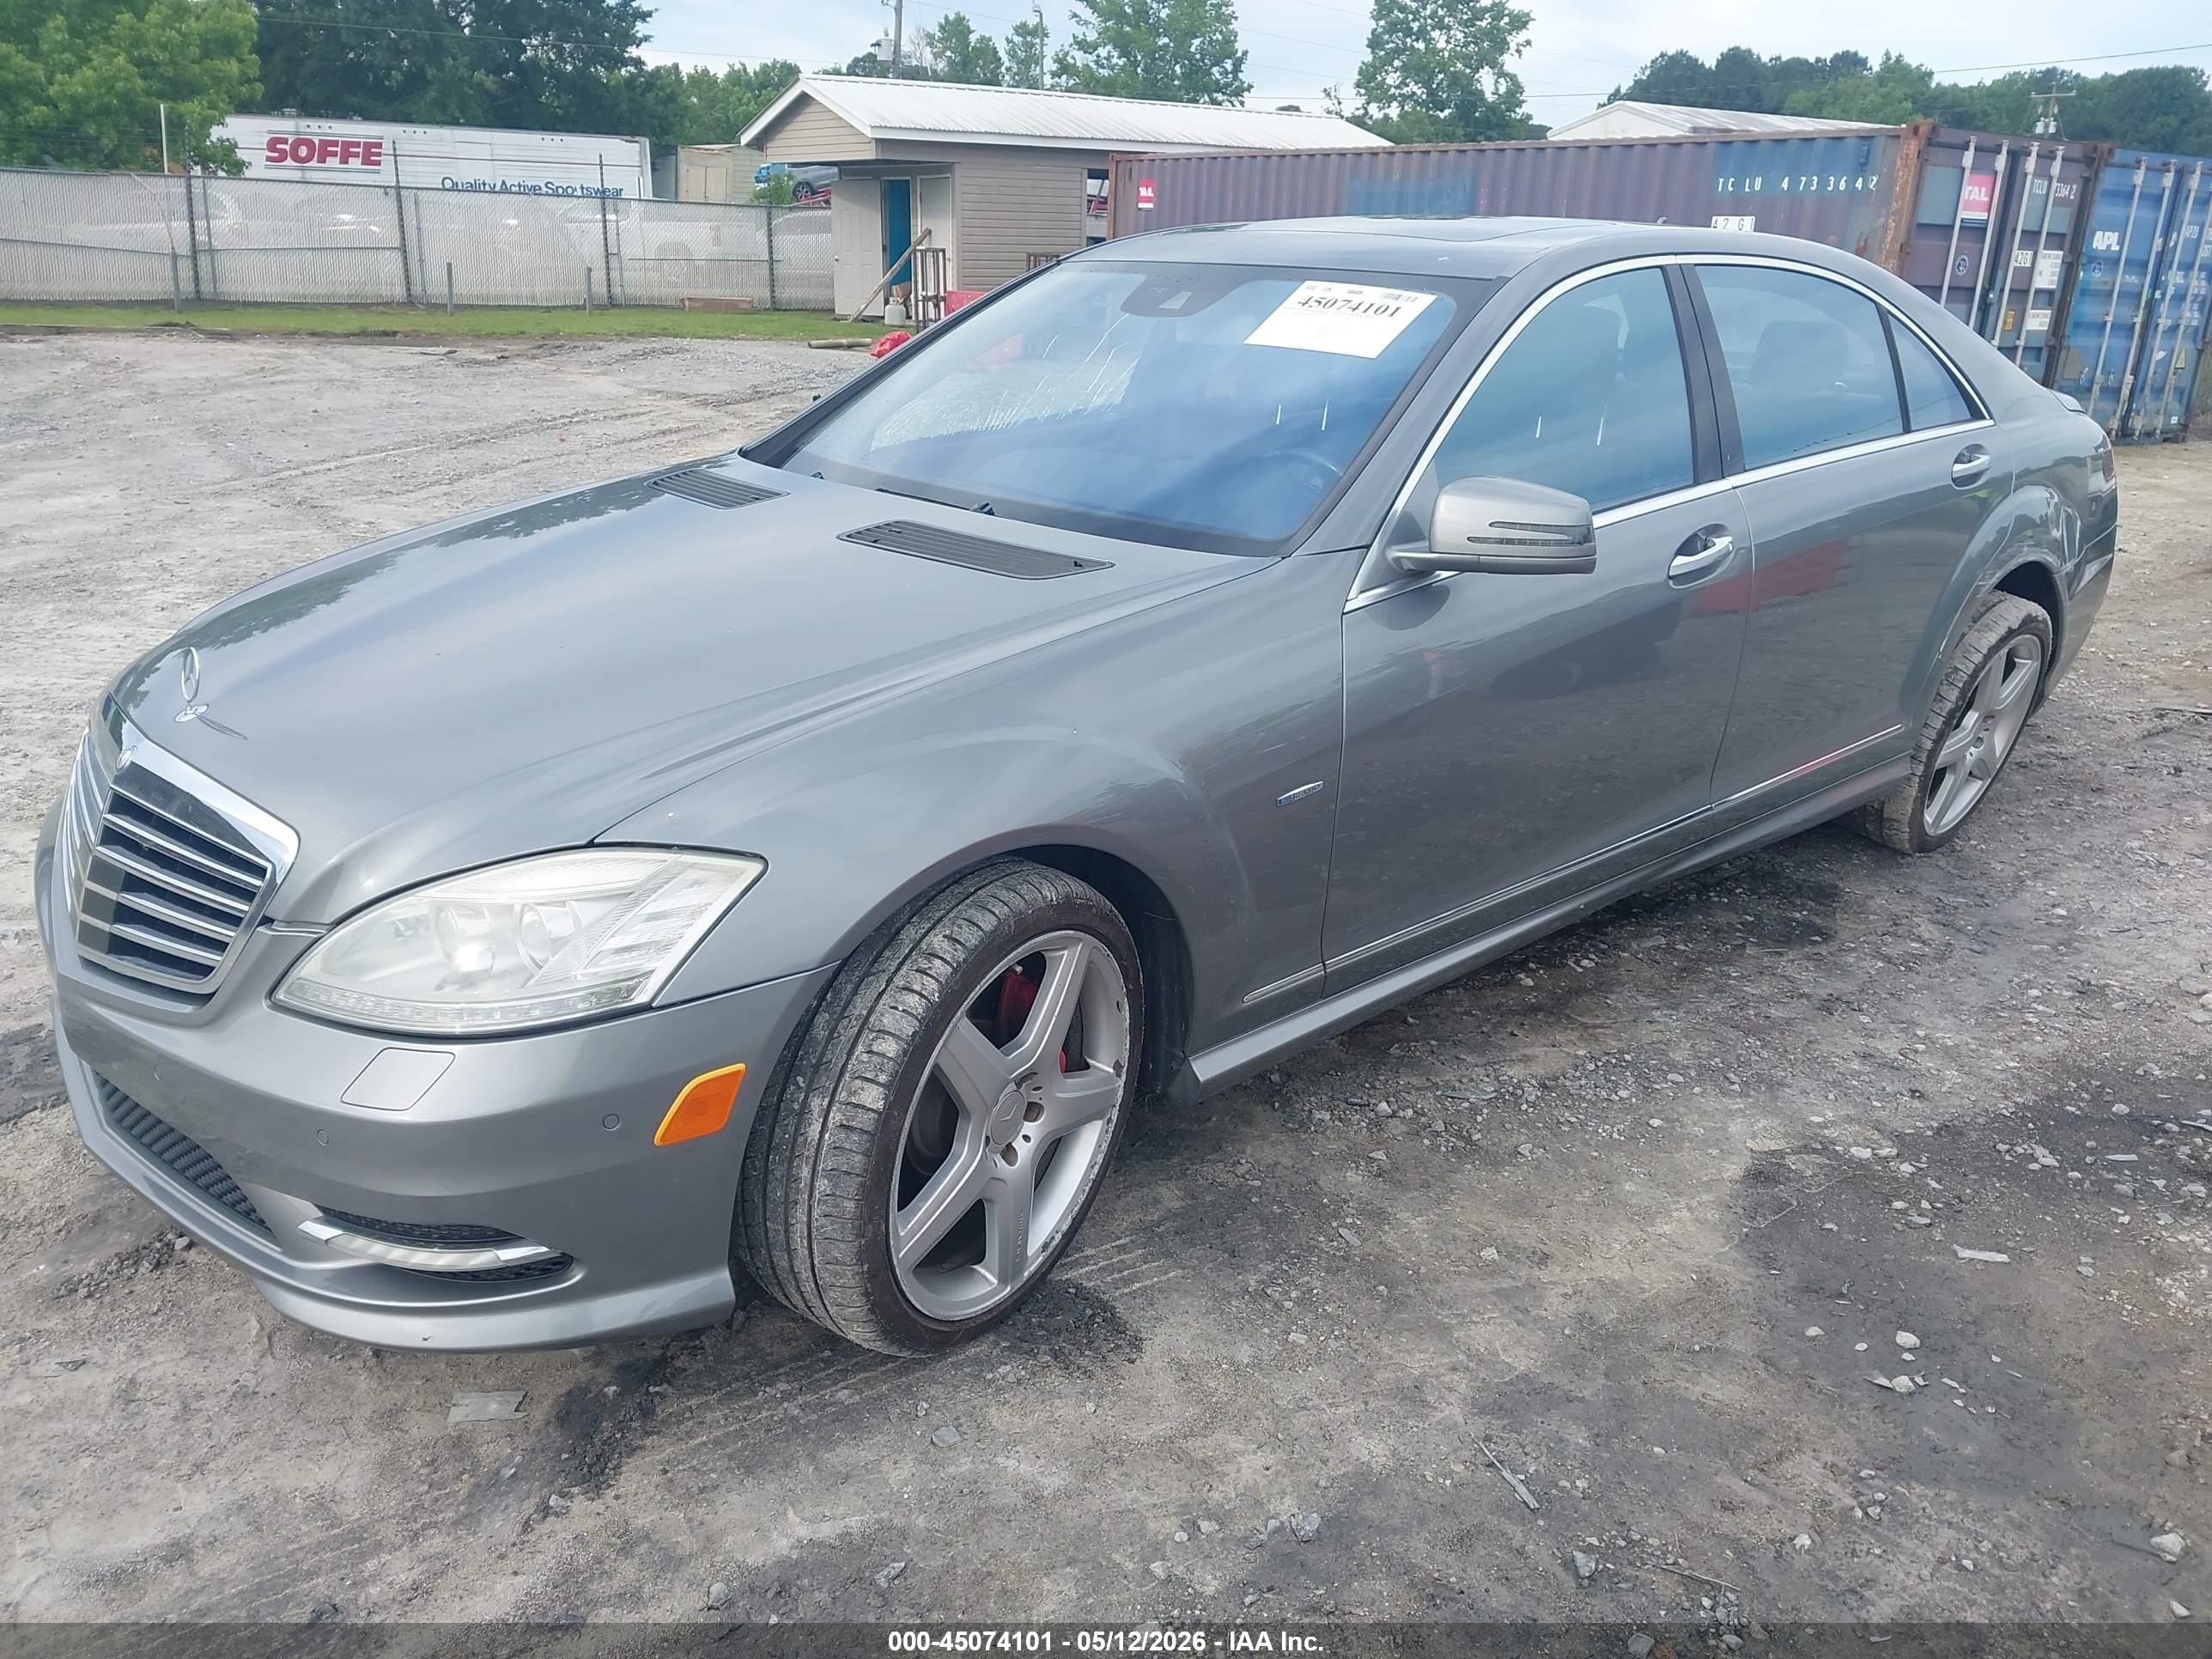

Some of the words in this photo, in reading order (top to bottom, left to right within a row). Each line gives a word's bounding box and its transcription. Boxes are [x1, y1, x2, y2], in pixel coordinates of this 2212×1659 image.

[265, 136, 383, 167] SOFFE
[441, 176, 496, 191] Quality
[499, 179, 543, 193] Active
[1717, 177, 1762, 192] TCLU
[1964, 185, 1989, 201] TAL
[2093, 230, 2120, 251] APL
[1297, 295, 1402, 318] 45074101
